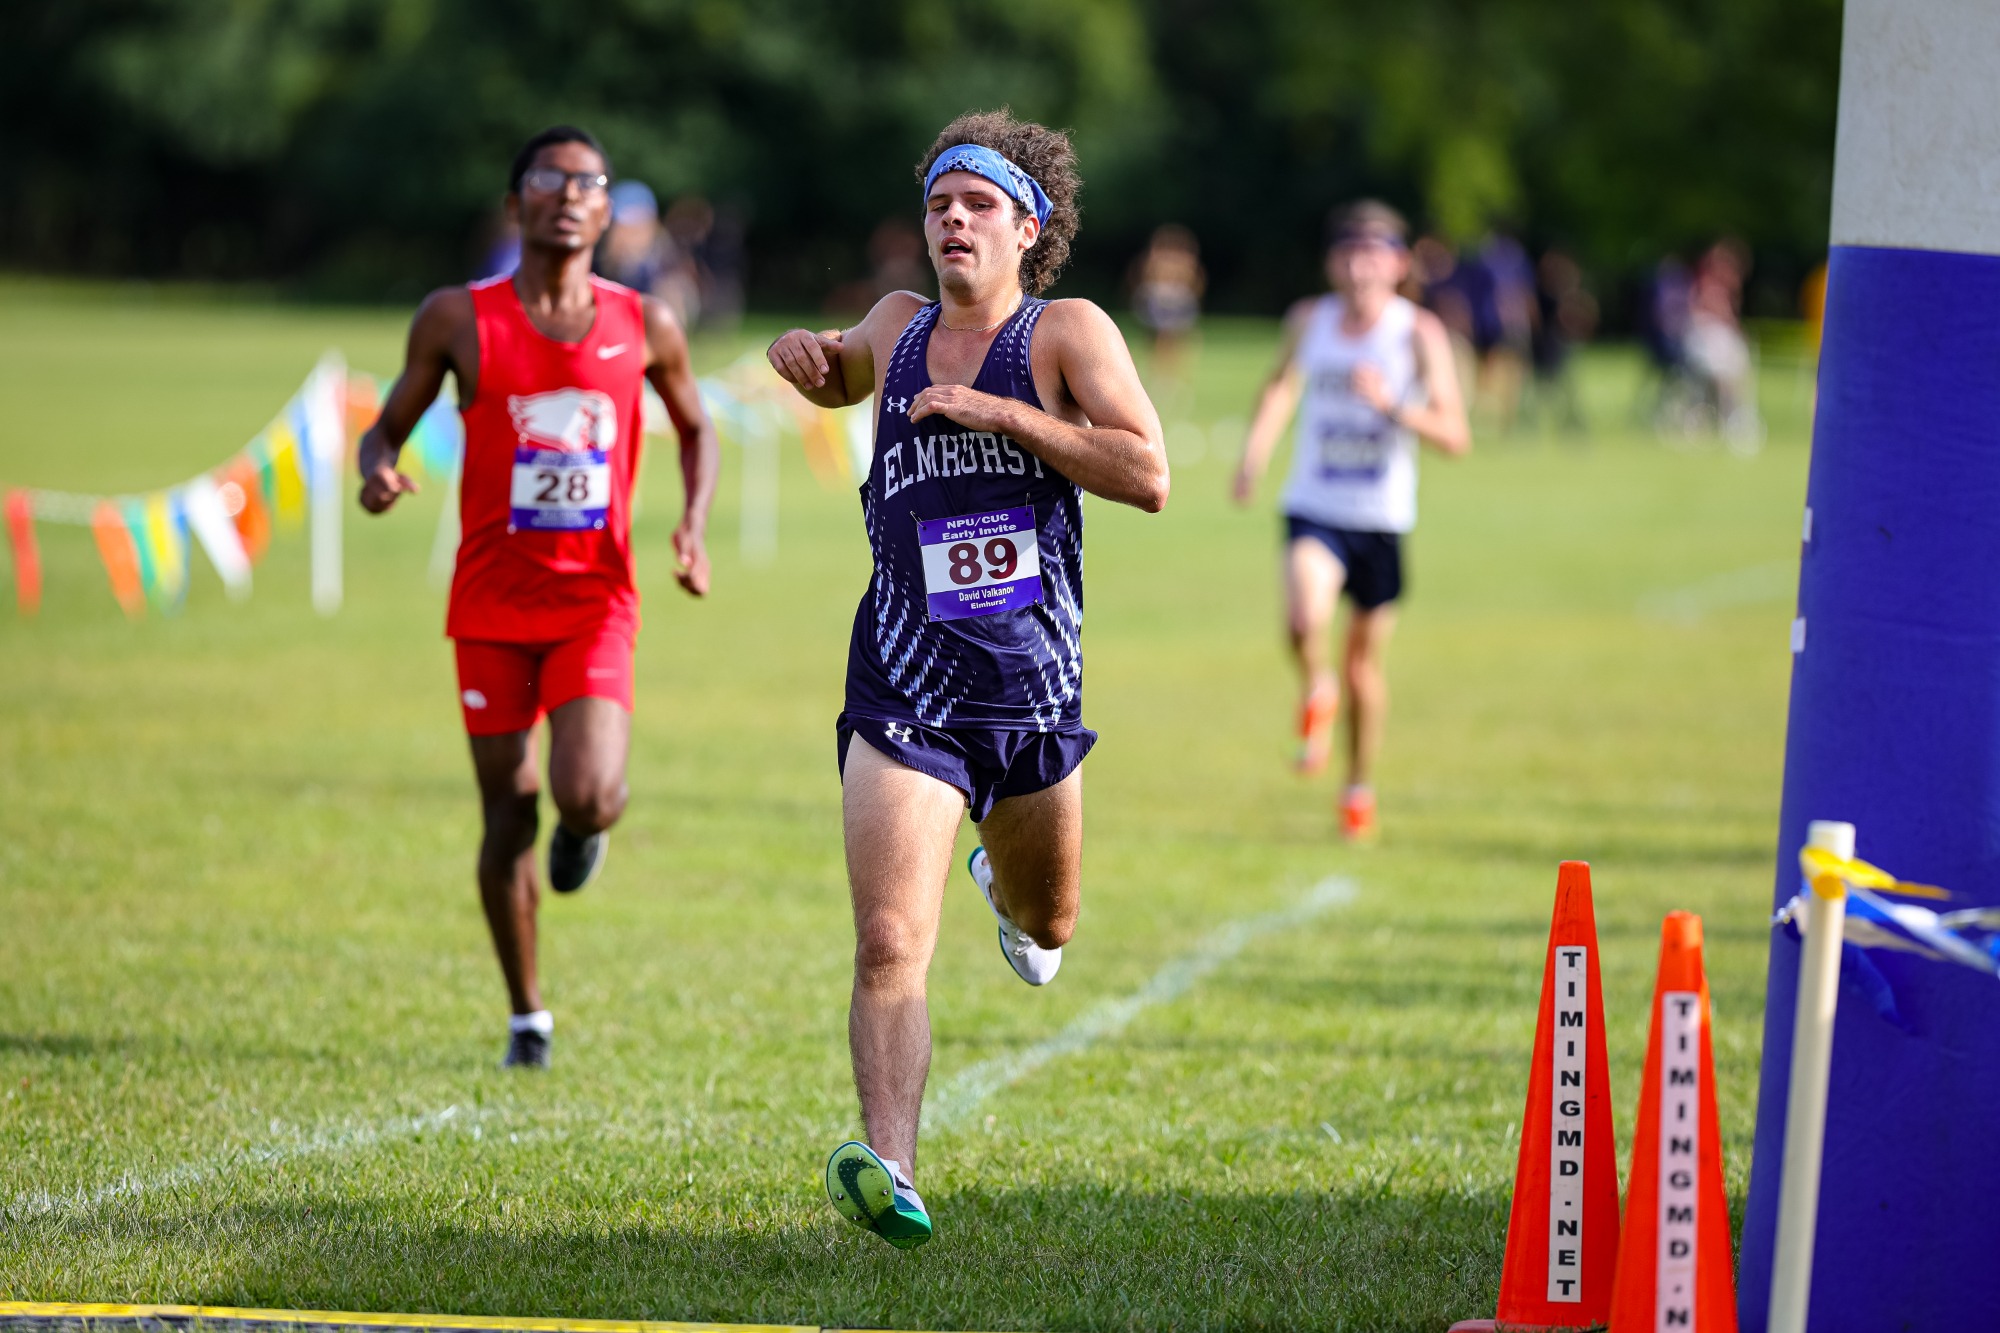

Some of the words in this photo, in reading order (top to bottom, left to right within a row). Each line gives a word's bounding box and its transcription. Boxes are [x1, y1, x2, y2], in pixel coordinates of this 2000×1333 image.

[535, 472, 589, 503] 28
[946, 513, 1010, 529] NPU/CUC
[942, 530, 976, 540] Early
[979, 523, 1017, 535] Invite
[948, 537, 1018, 585] 89
[958, 591, 980, 601] David
[981, 586, 1015, 599] Valkanov
[970, 598, 1007, 609] Elmhurst
